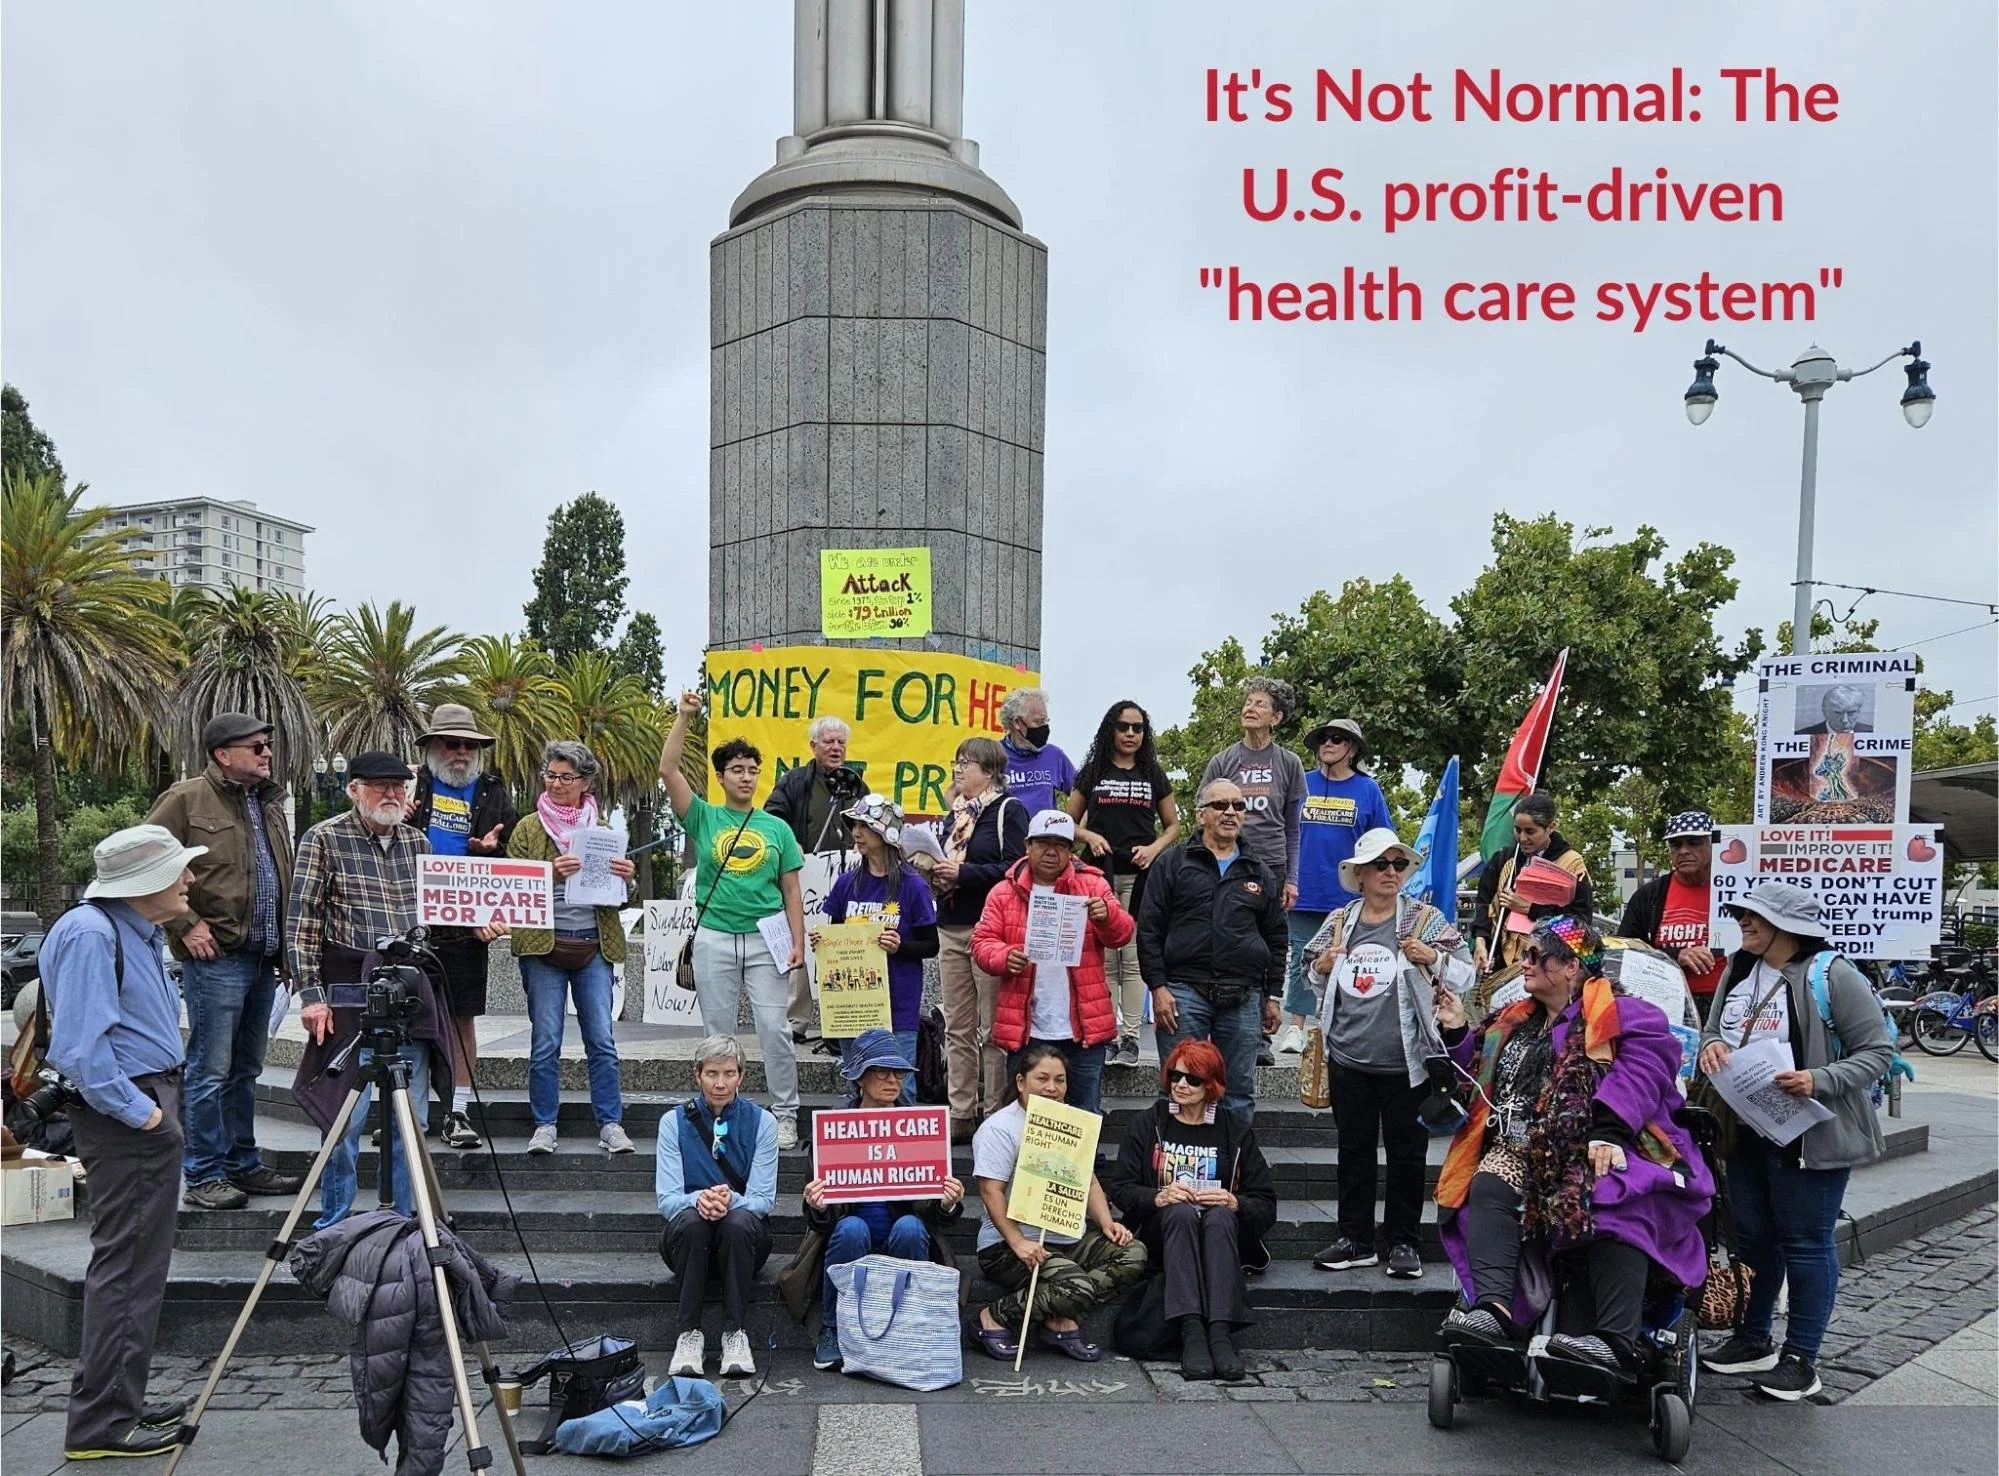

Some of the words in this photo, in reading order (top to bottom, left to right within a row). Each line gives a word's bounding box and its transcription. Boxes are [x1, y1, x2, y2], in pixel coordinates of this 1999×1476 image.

[907, 592, 922, 604] 1%
[1761, 663, 1803, 677] THE
[1811, 659, 1916, 675] CRIMINAL
[707, 666, 830, 720] MONEY
[855, 669, 960, 726] FOR
[1774, 741, 1809, 753] THE
[1854, 739, 1912, 751] CRIME
[1240, 769, 1273, 784] YES
[1243, 795, 1269, 811] NO
[1760, 830, 1807, 842] LOVE
[1810, 830, 1831, 842] IT!
[1788, 843, 1867, 855] IMPROVE
[1871, 843, 1893, 855] IT!
[423, 861, 467, 874] LOVE
[470, 863, 490, 875] IT!
[1759, 858, 1892, 873] MEDICARE
[451, 876, 523, 890] IMPROVE
[528, 879, 546, 891] IT!
[1713, 875, 1736, 888] 60
[1821, 876, 1885, 889] DON'T
[1893, 877, 1937, 890] CUT
[423, 889, 547, 909] MEDICARE
[1718, 891, 1737, 902] IT
[1824, 893, 1867, 906] CAN
[1873, 892, 1932, 905] HAVE
[423, 906, 476, 923] FOR
[490, 908, 547, 926] ALL!
[1817, 908, 1859, 921] NEY
[1872, 906, 1933, 923] trump
[1660, 923, 1707, 941] FIGHT
[1742, 1019, 1780, 1030] ATION
[823, 1119, 891, 1140] HEALTH
[895, 1117, 939, 1137] CARE
[1029, 1114, 1083, 1136] HEALTHCARE
[1025, 1136, 1052, 1149] RIGHT
[1027, 1127, 1035, 1135] IS
[1045, 1132, 1078, 1148] HUMAN
[868, 1145, 883, 1161] IS
[886, 1144, 897, 1160] A
[825, 1167, 884, 1186] HUMAN
[888, 1166, 941, 1183] RIGHT.
[1047, 1182, 1057, 1192] LA
[1058, 1186, 1084, 1200] SALUD
[1044, 1195, 1053, 1203] ES
[1055, 1198, 1068, 1208] UN
[1042, 1203, 1082, 1221] DERECHO
[1040, 1213, 1080, 1230] HUMANO
